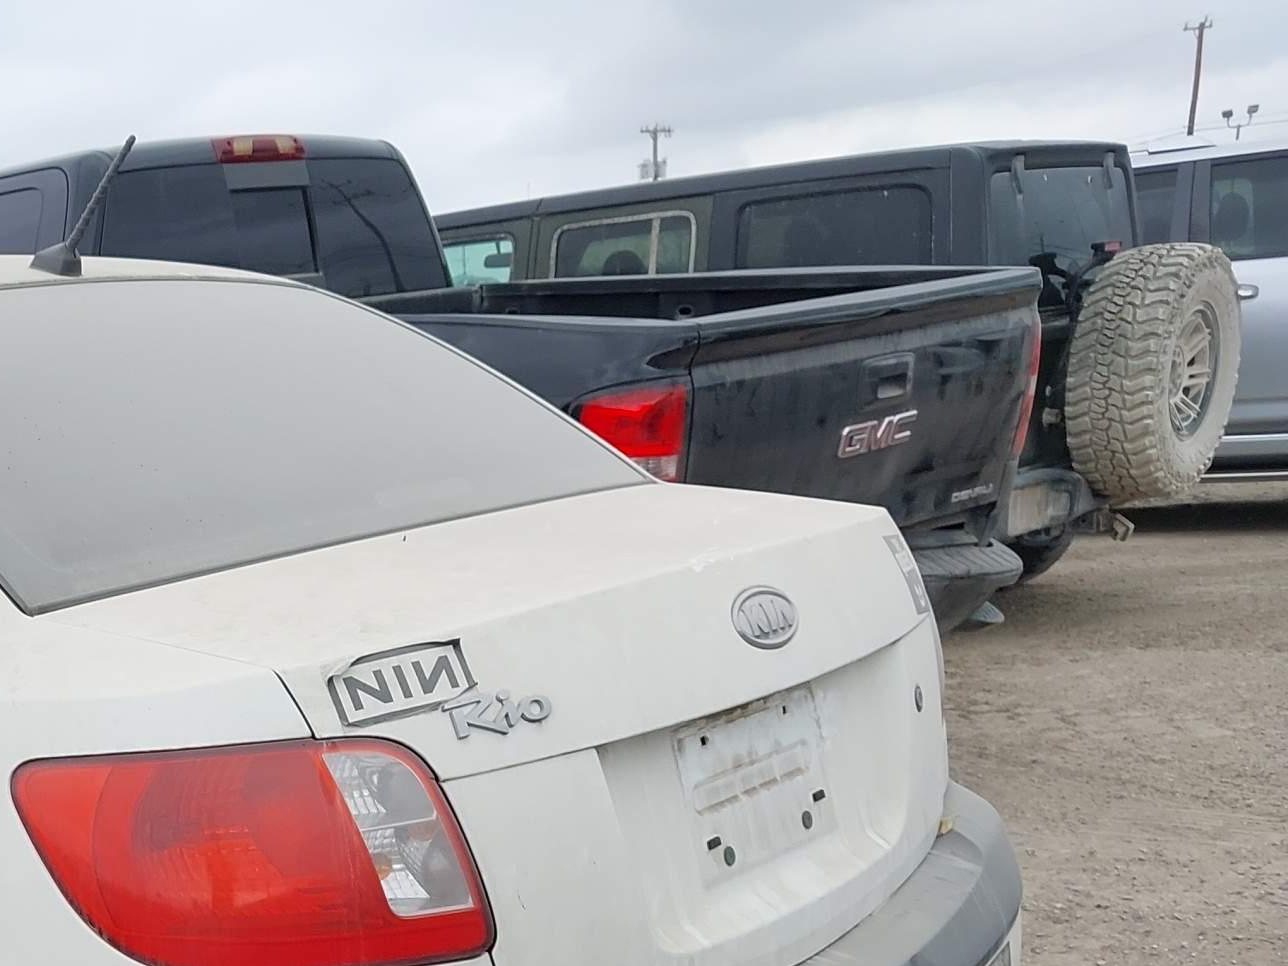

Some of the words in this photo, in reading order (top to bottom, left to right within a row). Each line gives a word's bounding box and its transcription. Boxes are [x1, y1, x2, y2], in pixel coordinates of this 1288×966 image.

[838, 410, 918, 458] GMC
[735, 597, 794, 640] KIA
[441, 688, 552, 740] Rio
